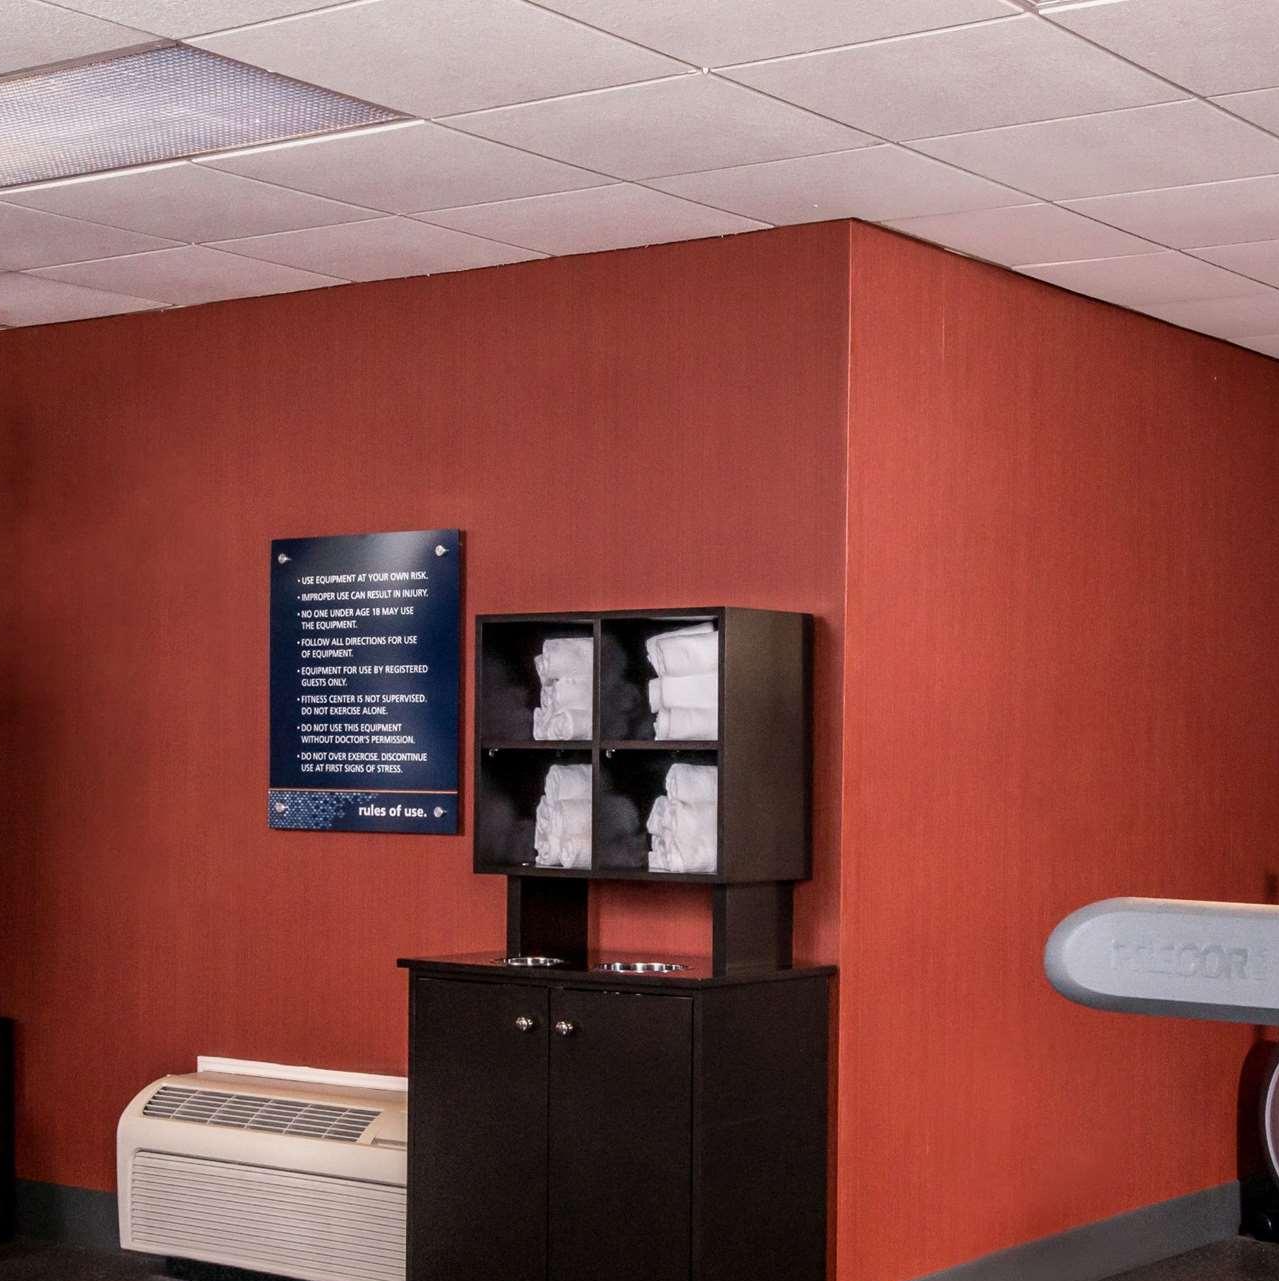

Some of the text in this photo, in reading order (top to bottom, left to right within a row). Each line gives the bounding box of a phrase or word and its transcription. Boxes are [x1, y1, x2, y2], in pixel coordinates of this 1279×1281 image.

[302, 571, 428, 585] USE EQUIPMENT AT YOUR OWN RISK.
[301, 589, 429, 601] IMPROPER USE CAN RESULT IN INJURY.
[301, 607, 414, 618] NO ONE UNDER AGE 18 MAY USE
[302, 620, 357, 630] THE EQUIPMENT.
[301, 635, 418, 646] FOLLOW ALL DIRECTIONS FOR USE
[301, 649, 353, 659] OF EQUIPMENT.
[301, 665, 428, 675] EQUIPMENT FOR USE BY REGISTERED
[301, 678, 347, 686] GUESTS ONLY.
[301, 694, 427, 703] FITNESS CENTER IS NOT SUPERVISED.
[301, 707, 388, 715] DO NOT EXERCISE ALONE.
[360, 724, 402, 733] EQUIPMENT
[371, 736, 415, 744] PERMISSION.
[301, 752, 312, 760] DO
[313, 752, 327, 760] NOT
[328, 752, 347, 760] OVER
[381, 752, 427, 761] DISCONTINUE
[301, 764, 403, 773] USE AT FIRST SIGNS OF STRESS.
[359, 804, 427, 817] rules of use.
